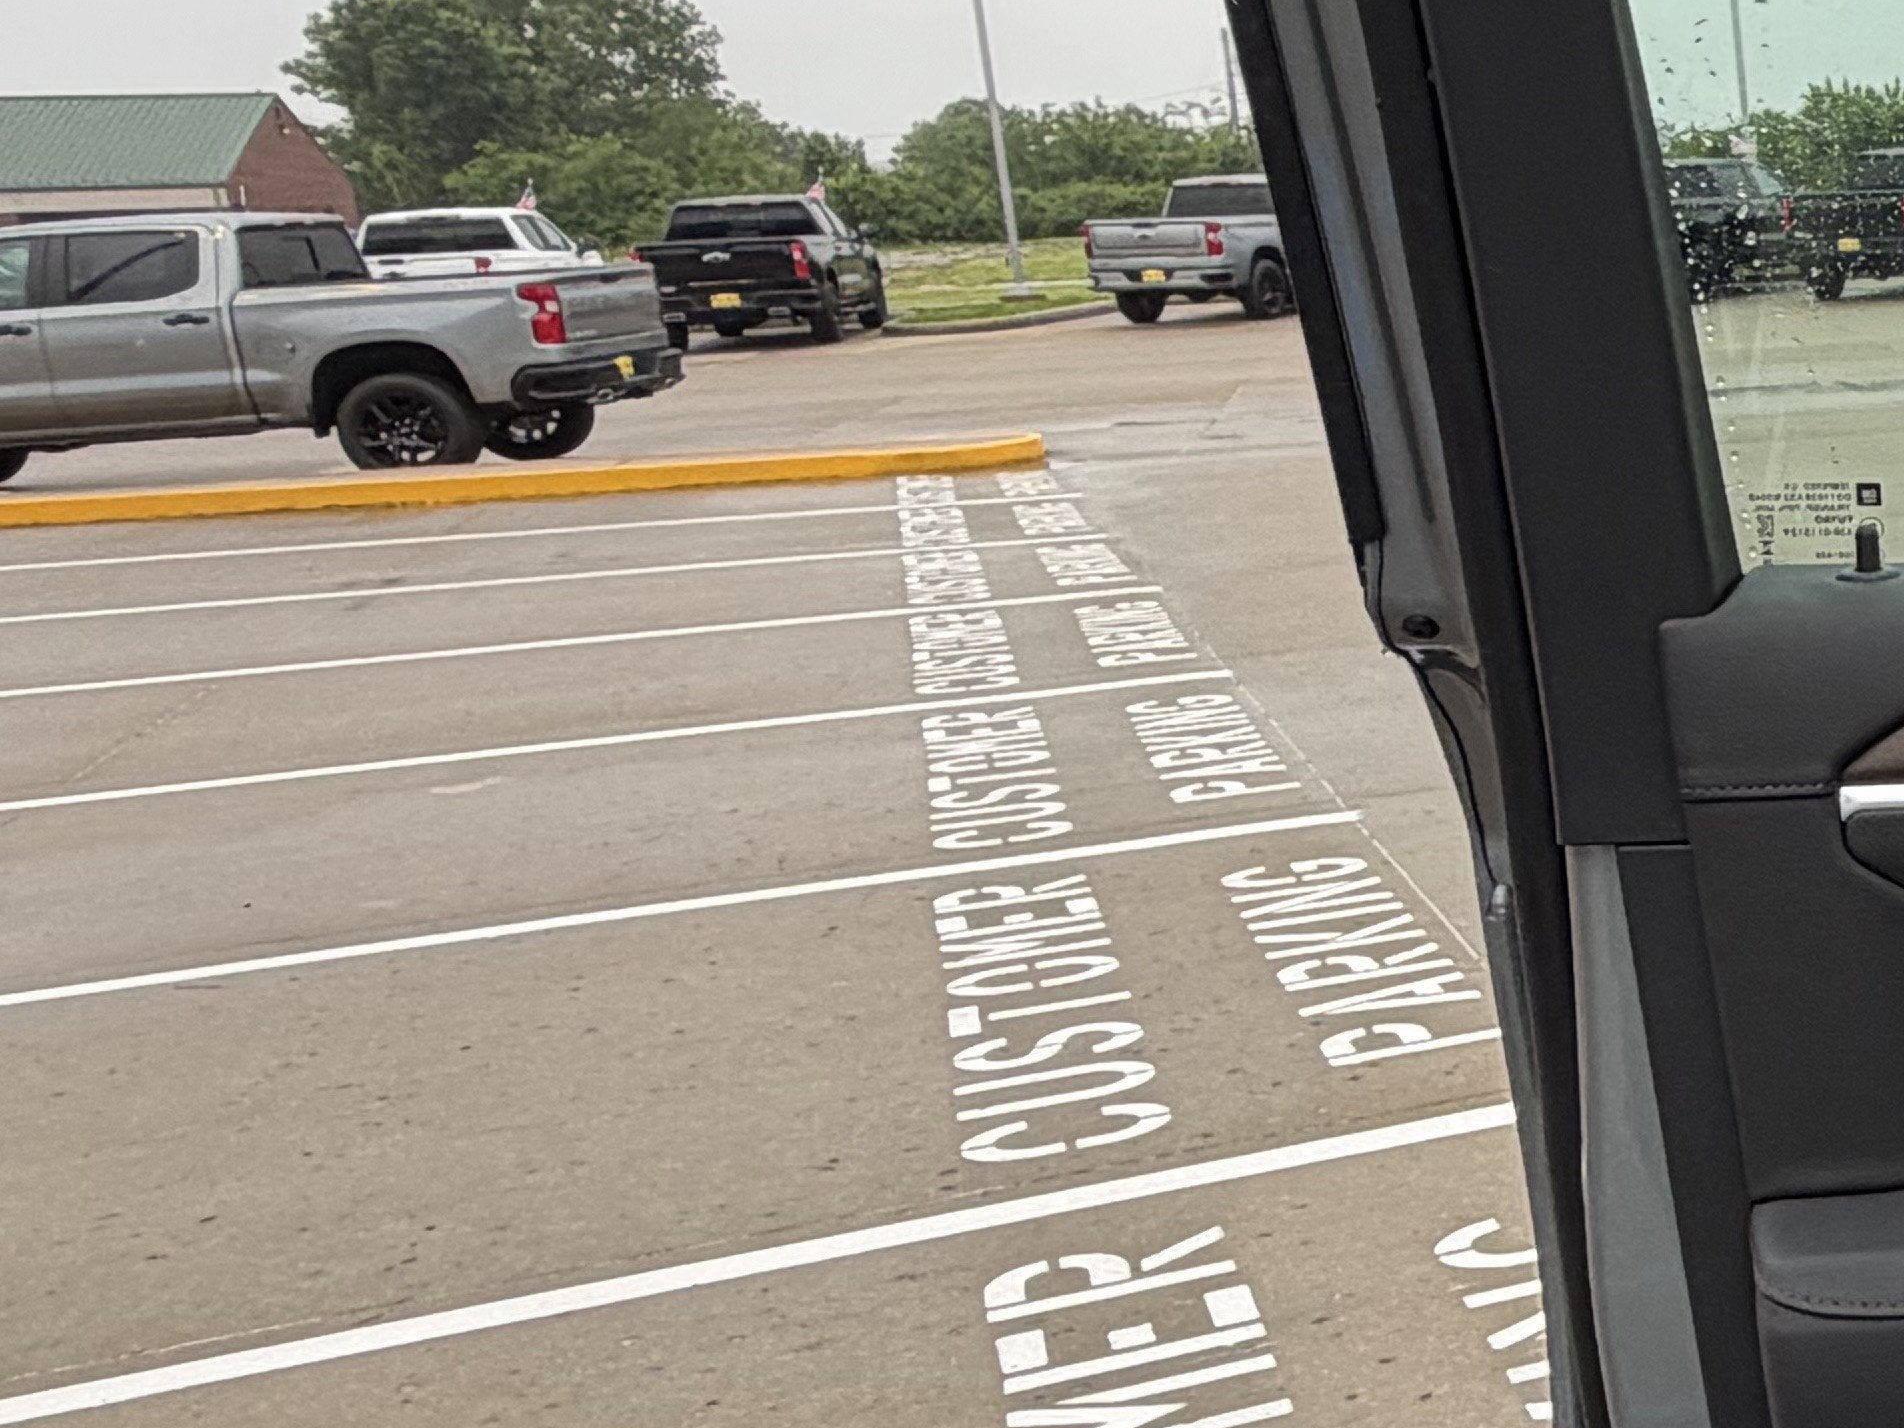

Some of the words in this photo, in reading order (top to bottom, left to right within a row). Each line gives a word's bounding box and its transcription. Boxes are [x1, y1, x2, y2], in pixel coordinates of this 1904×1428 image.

[908, 607, 1020, 695] CUSTOMER
[1073, 600, 1198, 668] PARKING
[921, 705, 1074, 851] CUSTOMER
[1125, 693, 1301, 803] PARKING
[932, 873, 1172, 1164] CUSTOMER
[1220, 857, 1502, 1067] PARKING
